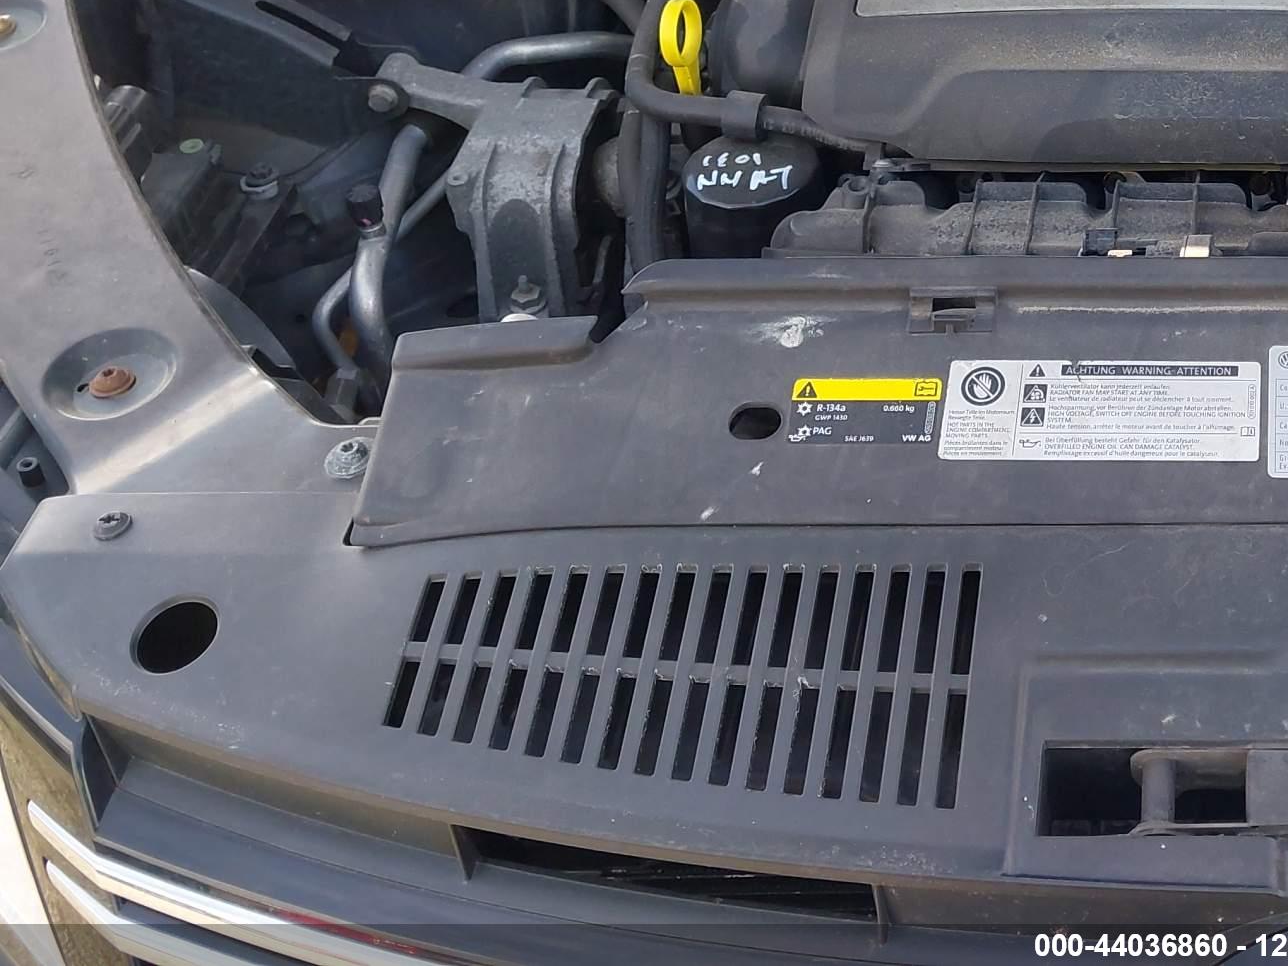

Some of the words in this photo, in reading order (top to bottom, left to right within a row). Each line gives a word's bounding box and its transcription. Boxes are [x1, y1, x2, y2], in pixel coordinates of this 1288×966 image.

[1066, 366, 1115, 375] ACHTUNG
[1121, 366, 1171, 375] WARNING
[1177, 367, 1231, 376] ATTENTION
[816, 404, 846, 412] R-134a
[905, 405, 915, 413] kg
[812, 427, 832, 435] PAG
[1280, 439, 1288, 447] No
